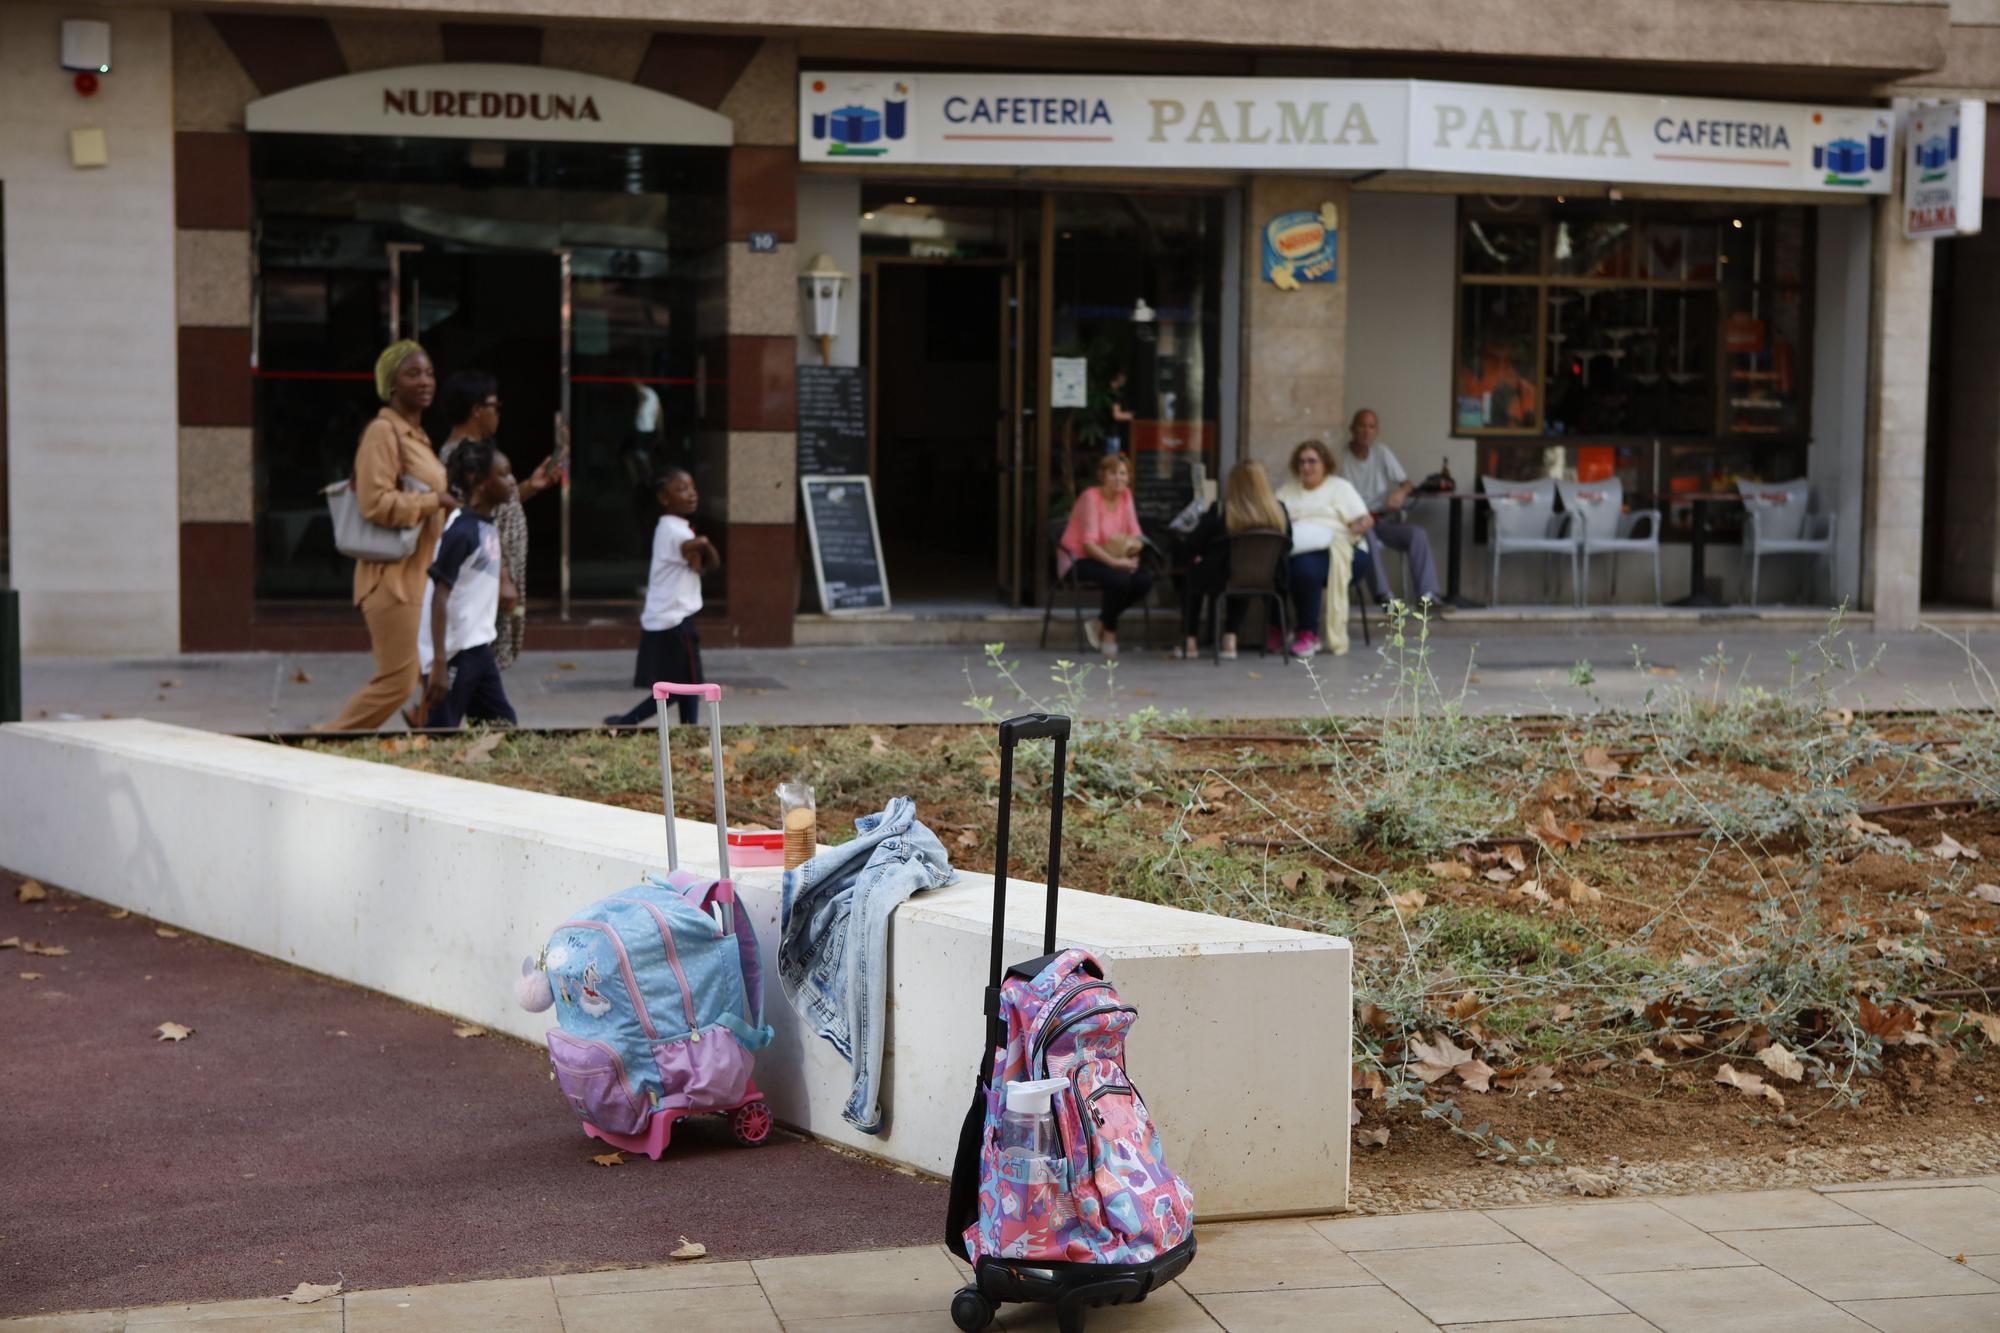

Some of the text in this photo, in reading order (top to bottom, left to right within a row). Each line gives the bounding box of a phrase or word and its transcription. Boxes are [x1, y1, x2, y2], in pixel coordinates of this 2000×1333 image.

[383, 88, 602, 123] NUREDDUNA
[943, 96, 1379, 146] CAFETERIA PALMA
[1433, 104, 1791, 159] PALMA CAFETERIA
